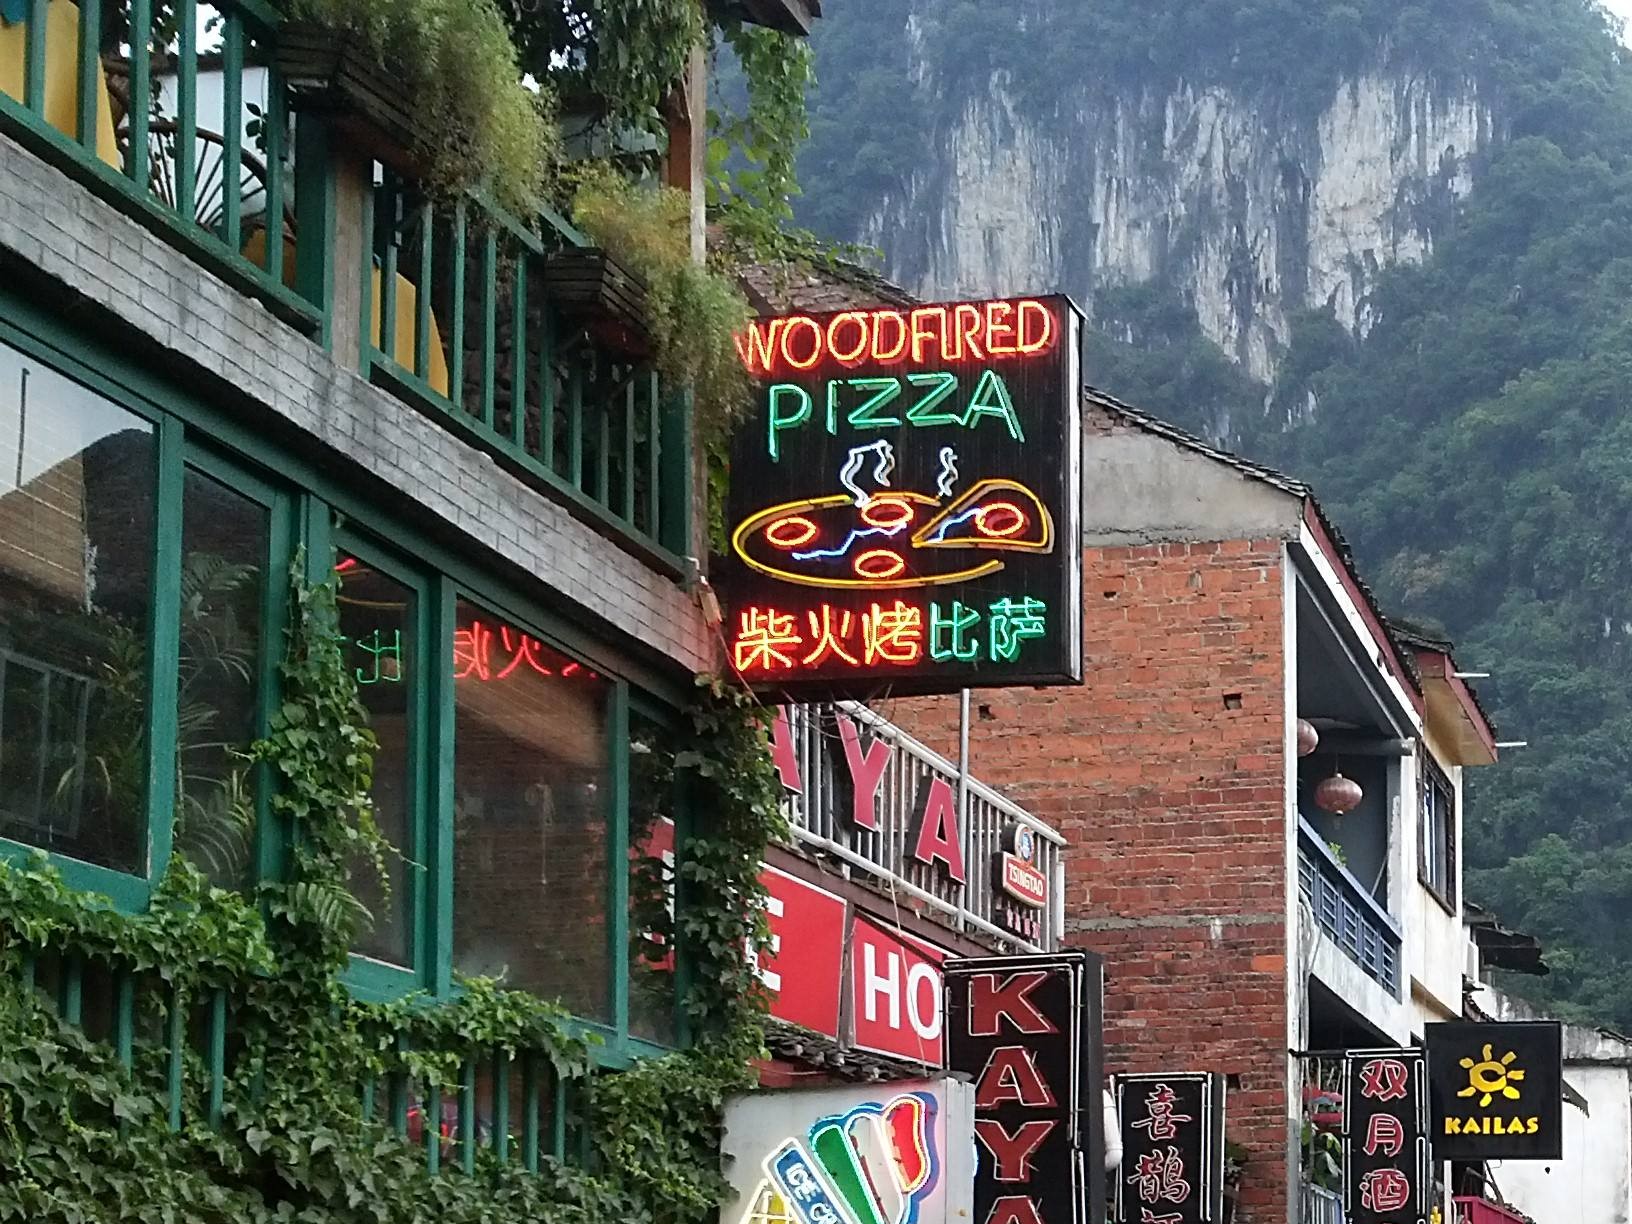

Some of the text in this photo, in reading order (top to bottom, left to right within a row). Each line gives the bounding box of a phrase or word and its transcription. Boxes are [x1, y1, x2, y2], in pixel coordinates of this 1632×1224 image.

[735, 300, 1056, 372] WOODFIRED
[769, 369, 1025, 462] PIZZA
[735, 596, 1046, 672] 柴火烤比萨
[1007, 861, 1045, 898] TSINGTAO
[1444, 1116, 1540, 1136] KAILAS
[785, 1161, 819, 1203] ICE
